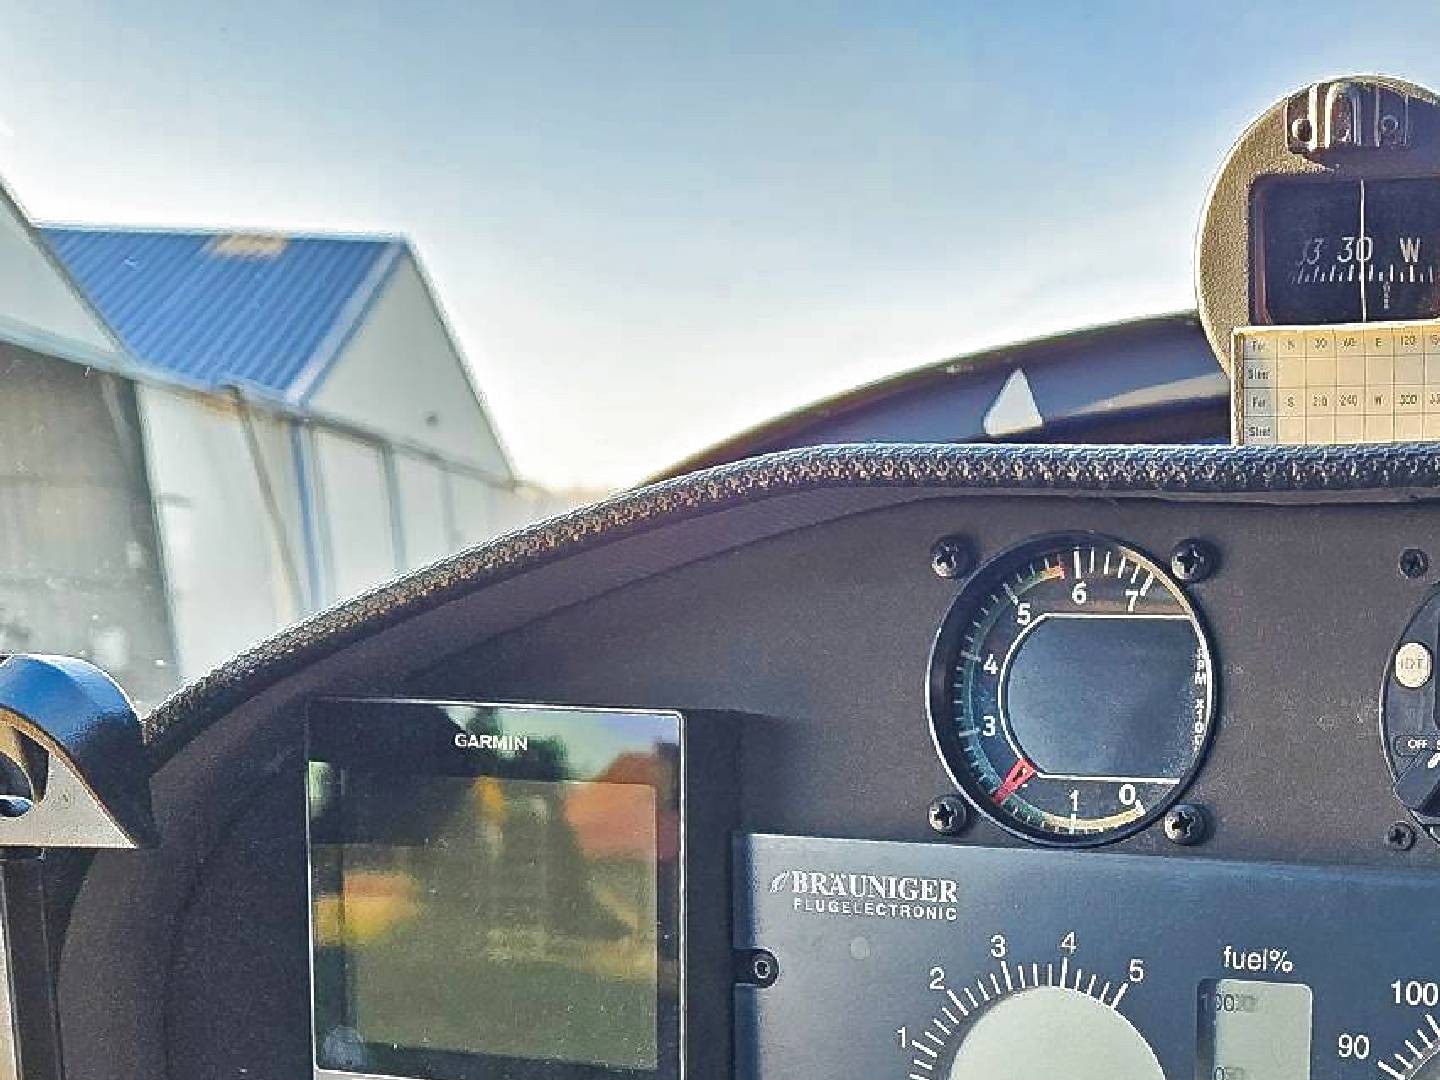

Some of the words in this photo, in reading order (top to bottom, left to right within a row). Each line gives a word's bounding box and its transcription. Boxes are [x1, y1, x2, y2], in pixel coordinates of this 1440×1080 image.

[1337, 236, 1374, 263] 30
[1399, 236, 1421, 263] W
[1071, 581, 1087, 604] 6
[1124, 590, 1139, 612] 7
[1016, 603, 1031, 626] 5
[982, 653, 999, 675] 4
[982, 715, 996, 737] 3
[454, 732, 529, 752] GARMIN
[1407, 739, 1428, 750] OFF
[1068, 789, 1079, 812] 1
[1118, 783, 1136, 806] 0
[790, 869, 959, 904] BRÄUNIGER
[793, 897, 958, 921] FLUGELECTRONIC
[989, 934, 1007, 958] 3
[1060, 931, 1078, 955] 4
[1128, 958, 1145, 982] 5
[1222, 945, 1294, 974] fuel%
[929, 965, 945, 991] 2
[1390, 981, 1440, 1007] 100
[896, 1026, 907, 1049] 1
[1337, 1034, 1371, 1060] 90
